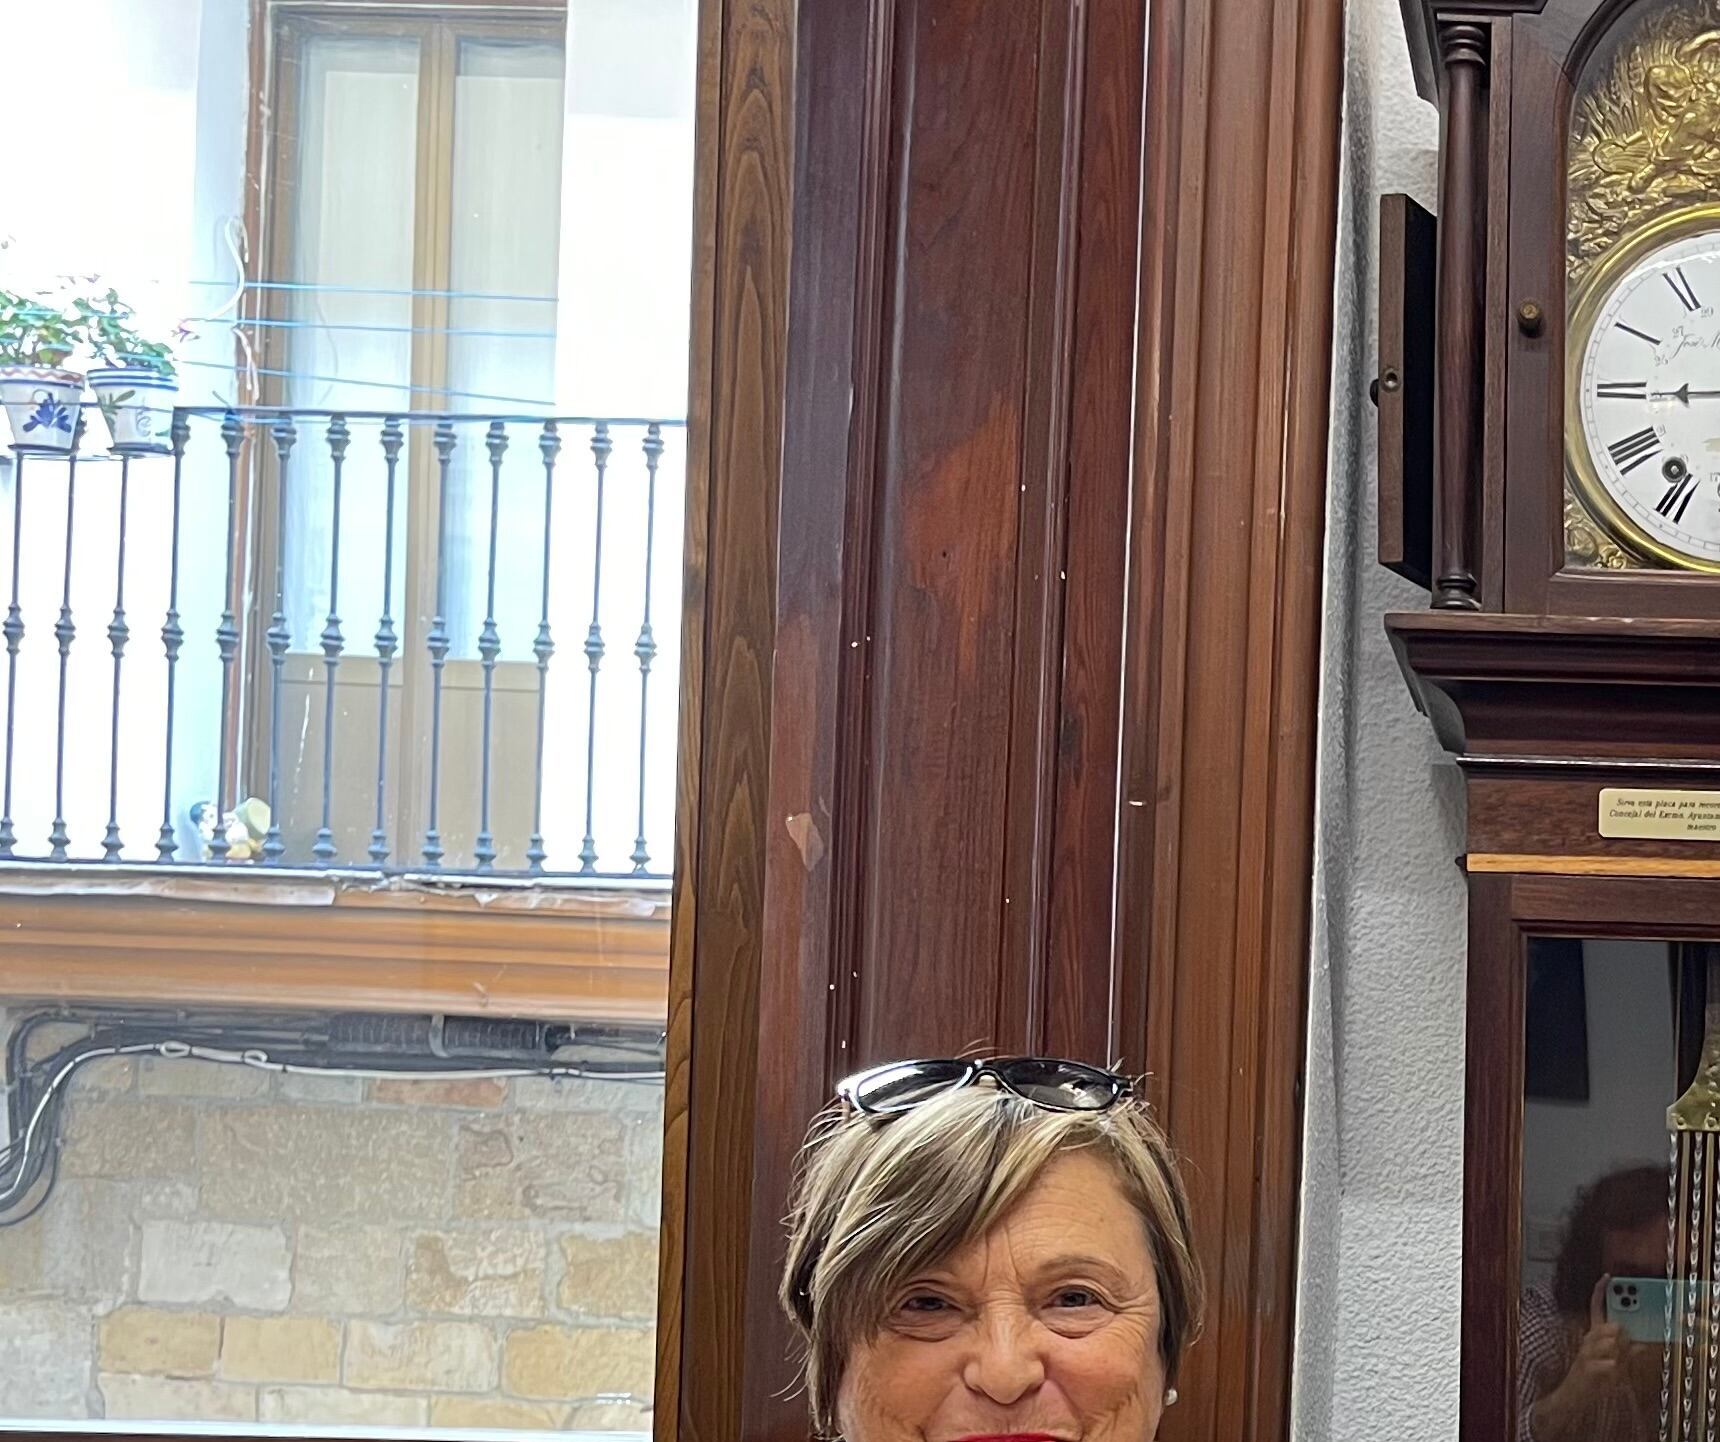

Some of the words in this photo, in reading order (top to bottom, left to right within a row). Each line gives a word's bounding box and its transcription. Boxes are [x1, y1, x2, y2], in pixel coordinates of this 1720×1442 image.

[1655, 799, 1676, 810] placa
[1678, 801, 1696, 810] para
[1609, 809, 1642, 818] Concejal
[1644, 810, 1657, 819] del
